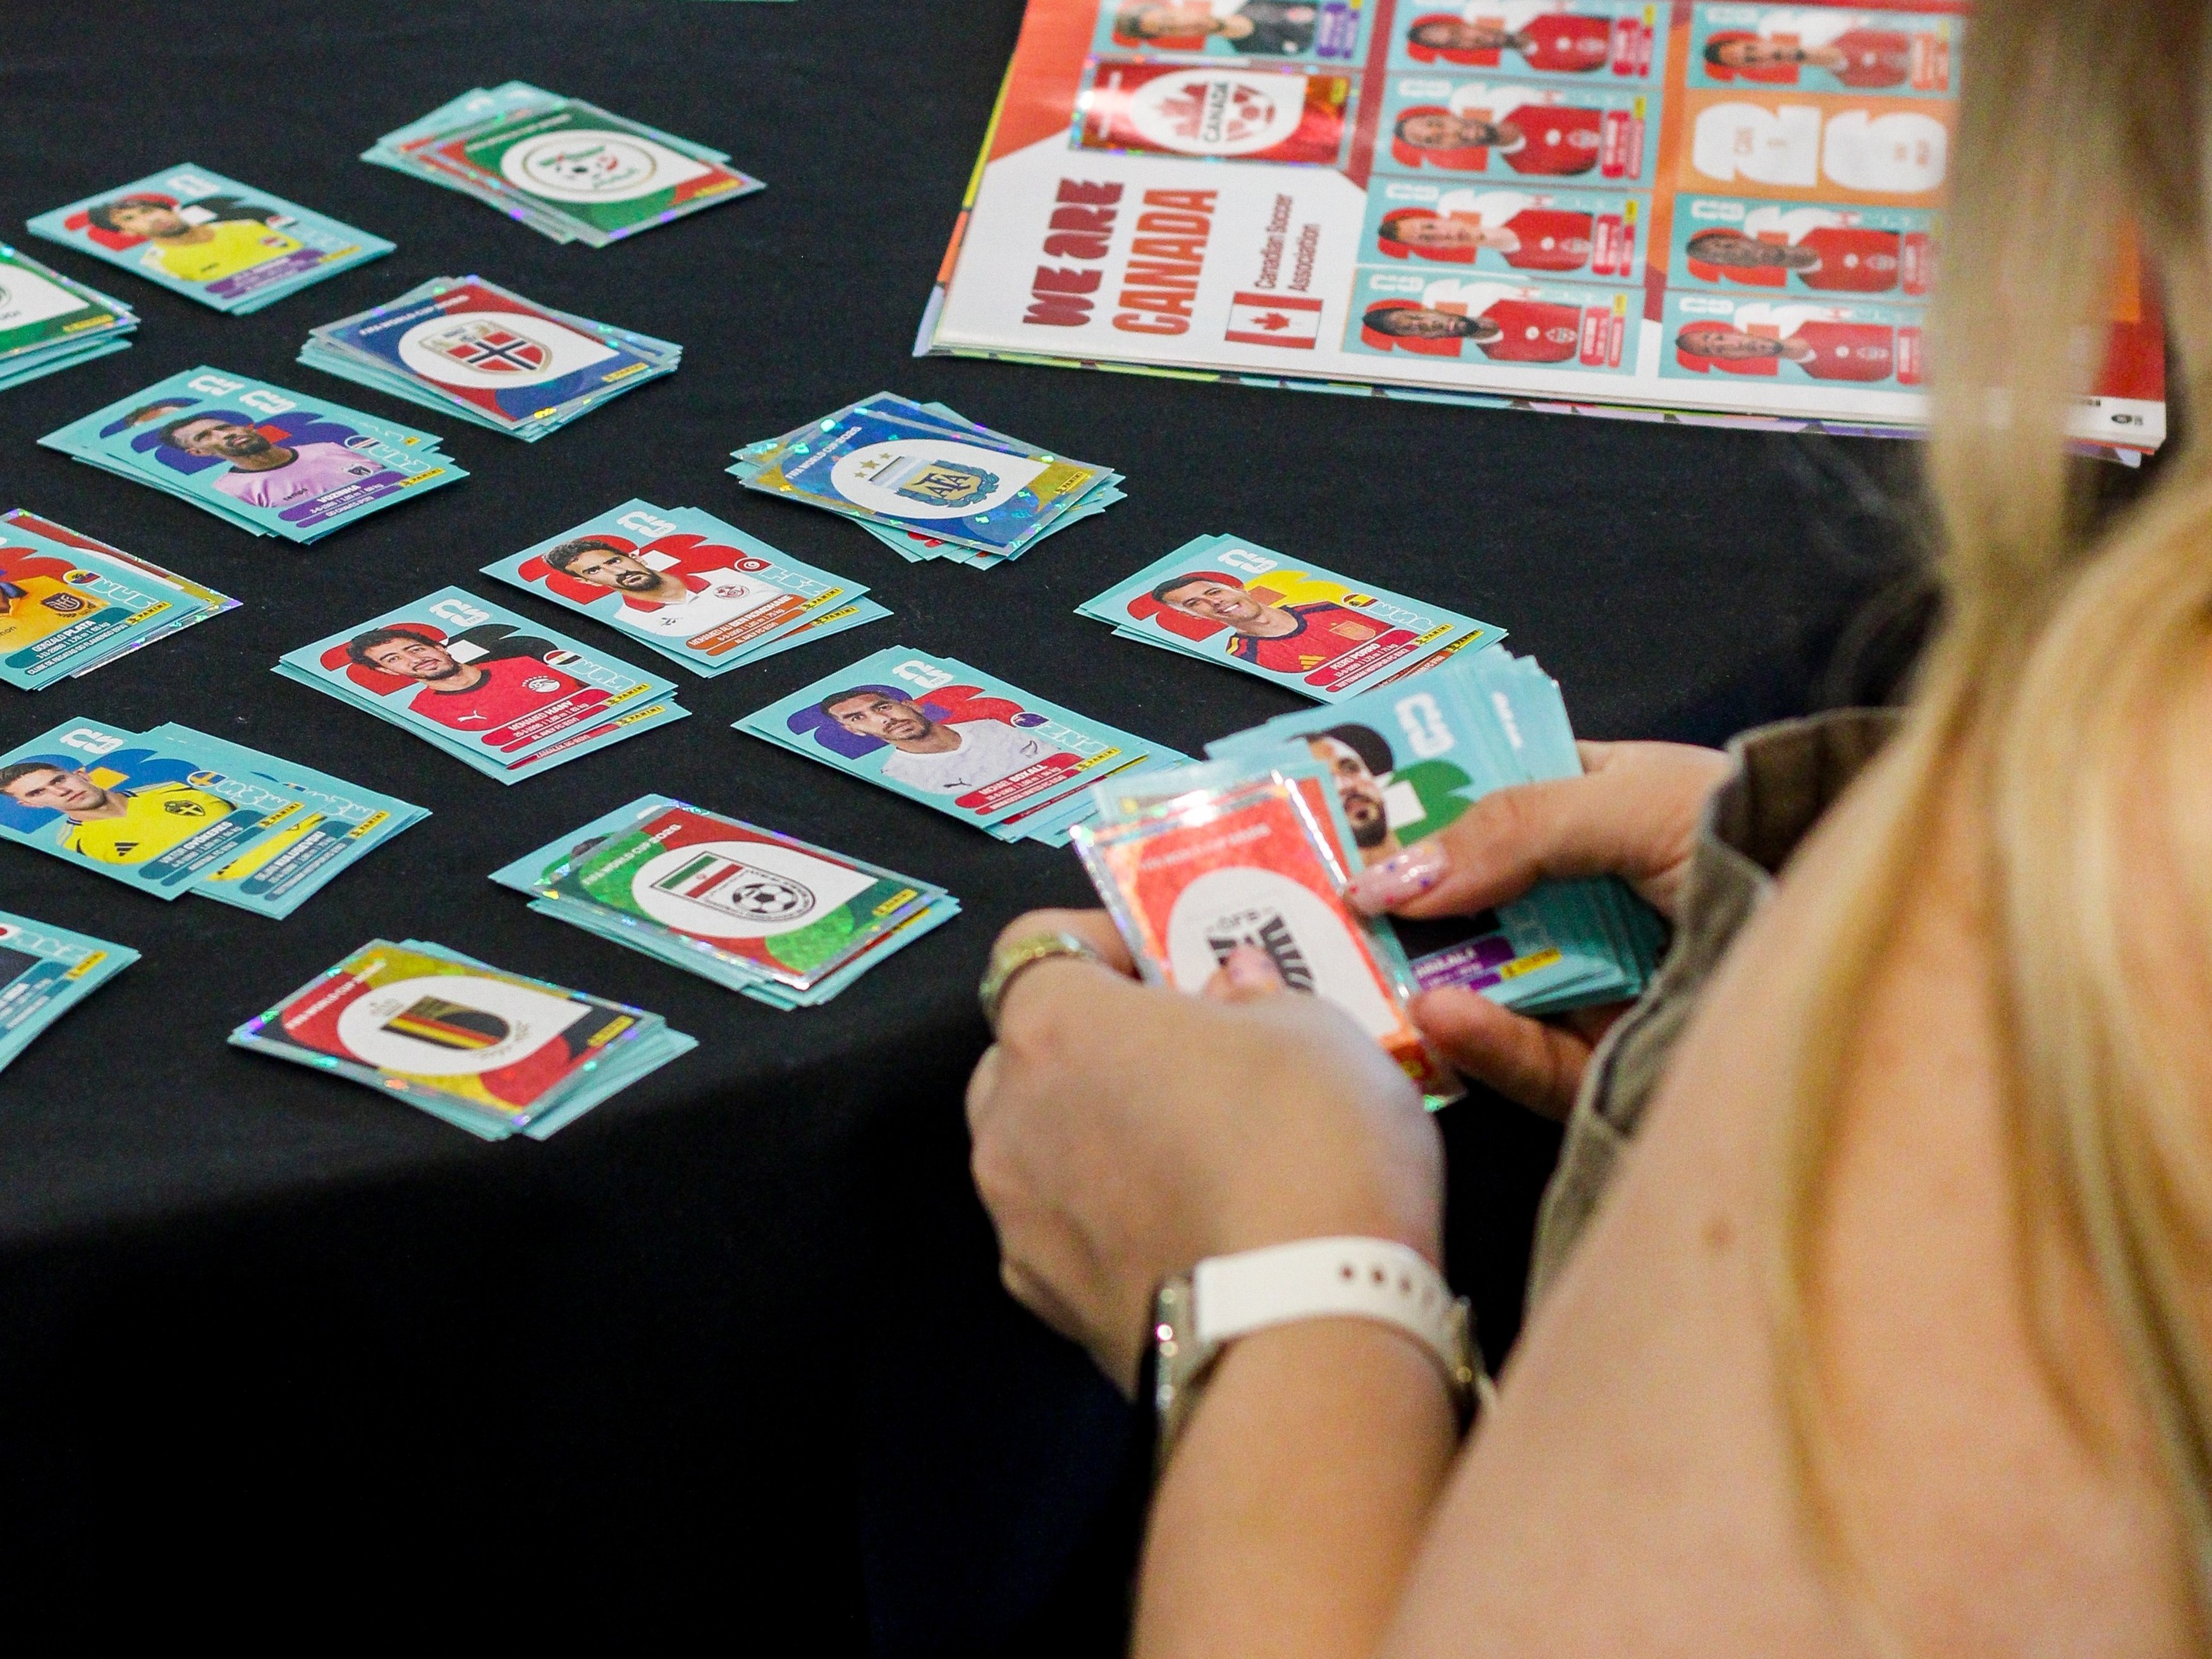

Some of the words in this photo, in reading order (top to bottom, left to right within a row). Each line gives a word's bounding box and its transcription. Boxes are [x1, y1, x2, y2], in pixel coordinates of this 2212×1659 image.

[1202, 81, 1229, 143] CANADA
[1042, 177, 1125, 260] ARE
[1265, 193, 1293, 233] Soccer
[1111, 189, 1218, 336] CANADA
[1254, 234, 1286, 289] Canadian
[1287, 222, 1320, 292] Association
[1022, 265, 1104, 328] WE
[786, 468, 802, 479] FIFA
[801, 453, 824, 469] WORLD
[823, 443, 838, 453] CUP
[835, 427, 862, 443] 2026
[317, 483, 360, 503] VOZINHA
[924, 471, 972, 497] AFA
[1061, 471, 1082, 490] PANINI
[138, 602, 167, 618] PANINI
[809, 587, 842, 605] PANINI
[689, 629, 721, 647] MOHAMED
[728, 616, 748, 628] BEN
[744, 594, 793, 619] ROMDHANE
[822, 606, 857, 623] PANINI
[33, 633, 64, 652] GONZALO
[64, 619, 94, 636] PLATA
[83, 629, 112, 647] FLAMENGO
[1423, 624, 1451, 638] PANINI
[1331, 657, 1354, 670] PEDRO
[1350, 643, 1381, 659] PORRO
[616, 683, 647, 700] PANINI
[510, 712, 546, 731] MOHAMED
[544, 700, 573, 715] HANY
[629, 705, 662, 722] PANINI
[1087, 748, 1118, 763] PANINI
[979, 779, 1009, 795] MICHAEL
[1008, 762, 1048, 782] BOXALL
[271, 803, 300, 821] PANINI
[359, 811, 385, 830] PANINI
[181, 819, 231, 851] GYÖKERES
[600, 851, 635, 873] WORLD
[648, 822, 683, 844] 2026
